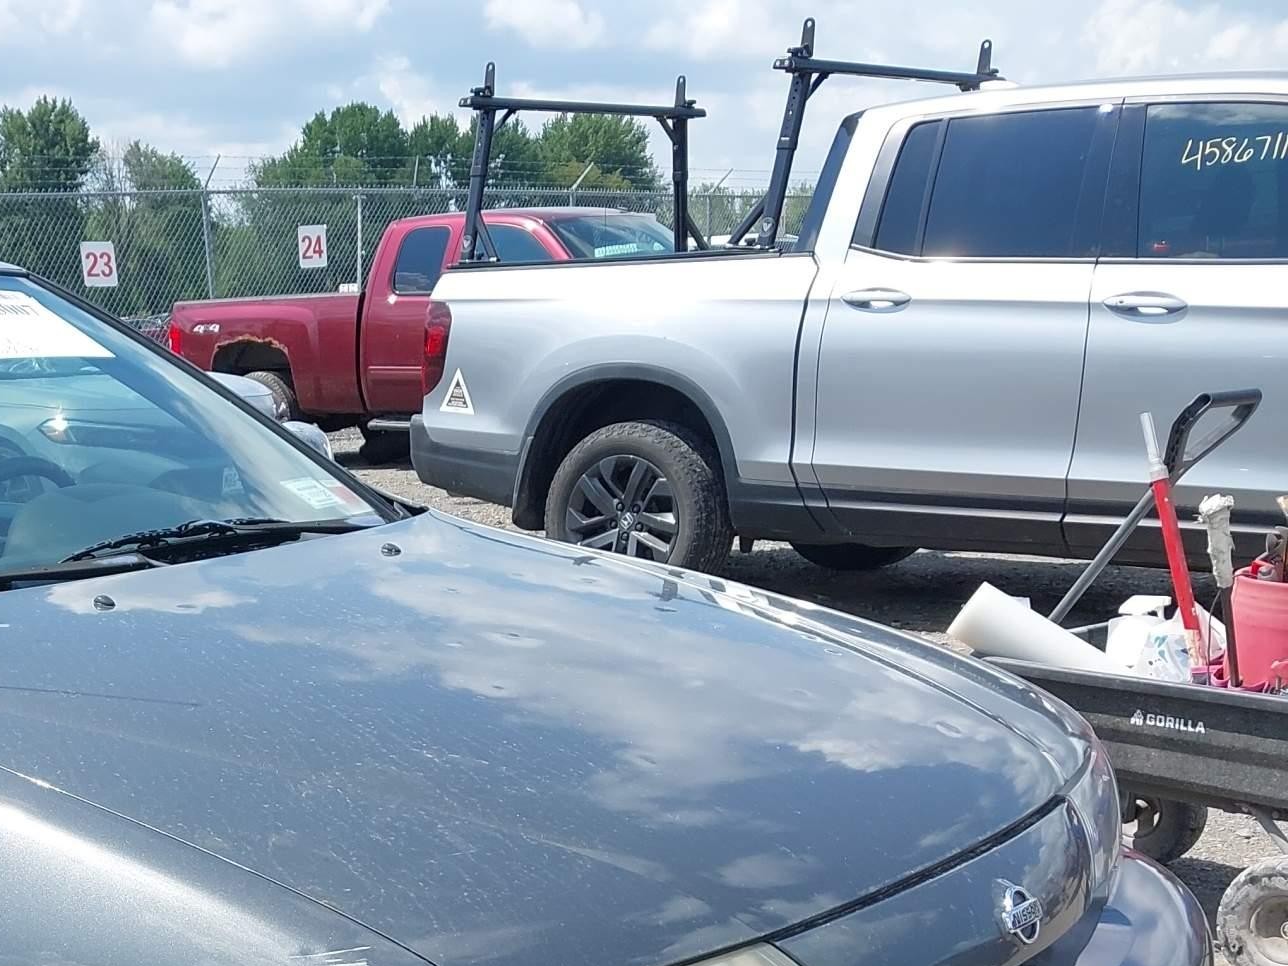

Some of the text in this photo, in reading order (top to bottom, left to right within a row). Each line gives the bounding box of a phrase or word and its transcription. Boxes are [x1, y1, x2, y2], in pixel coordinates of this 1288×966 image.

[301, 235, 324, 260] 24
[85, 252, 113, 278] 23
[1145, 713, 1206, 734] GORILLA
